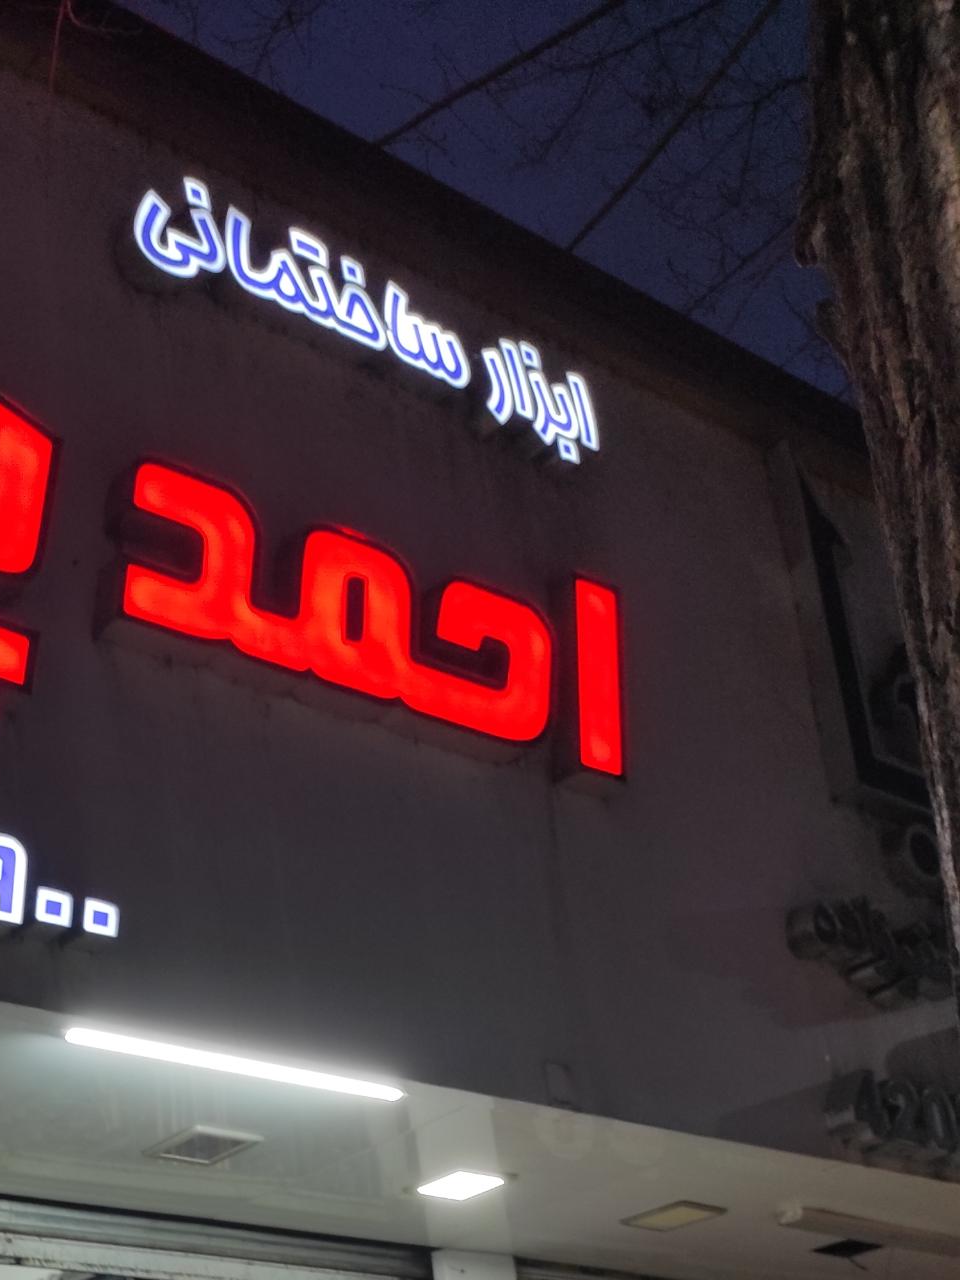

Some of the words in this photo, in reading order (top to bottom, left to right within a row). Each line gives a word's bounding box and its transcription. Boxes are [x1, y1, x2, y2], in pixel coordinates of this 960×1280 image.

[133, 176, 472, 389] ساختمانی
[481, 337, 600, 465] ابزار
[123, 462, 625, 778] احمد
